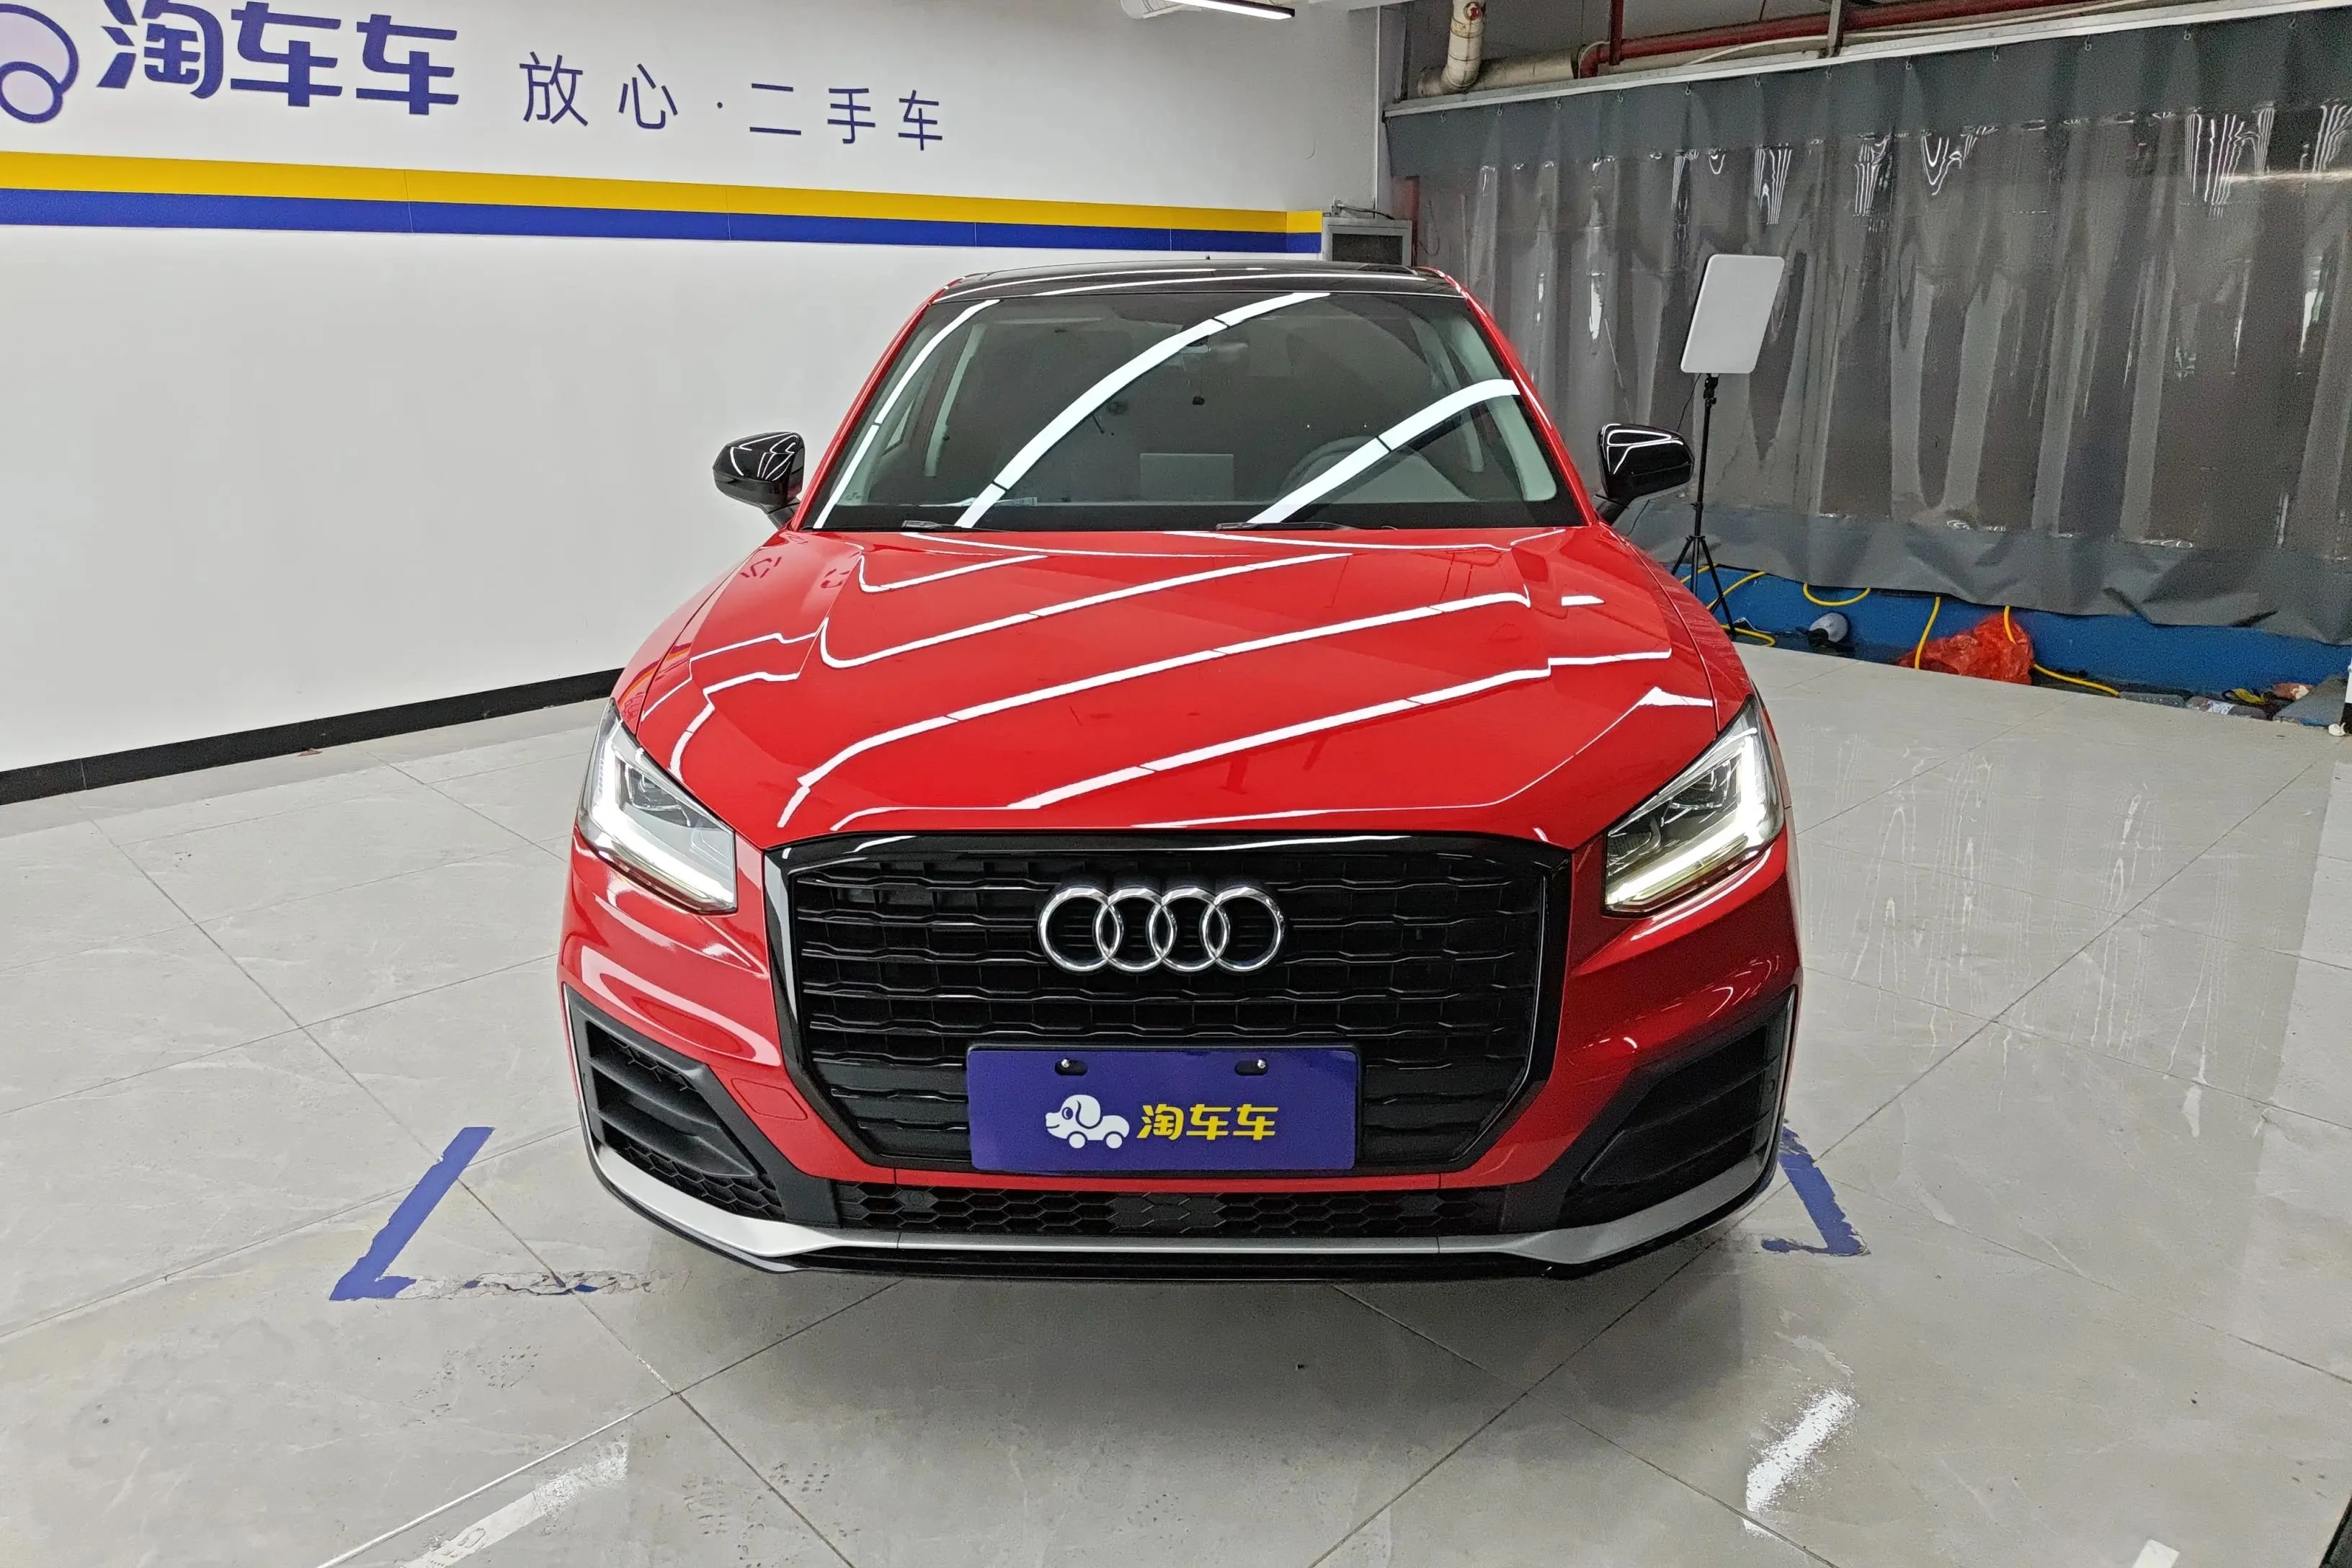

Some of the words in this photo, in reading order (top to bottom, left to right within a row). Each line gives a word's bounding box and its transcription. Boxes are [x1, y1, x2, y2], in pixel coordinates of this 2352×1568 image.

[97, 0, 459, 115] 淘车车
[1136, 1102, 1278, 1141] 淘车车
